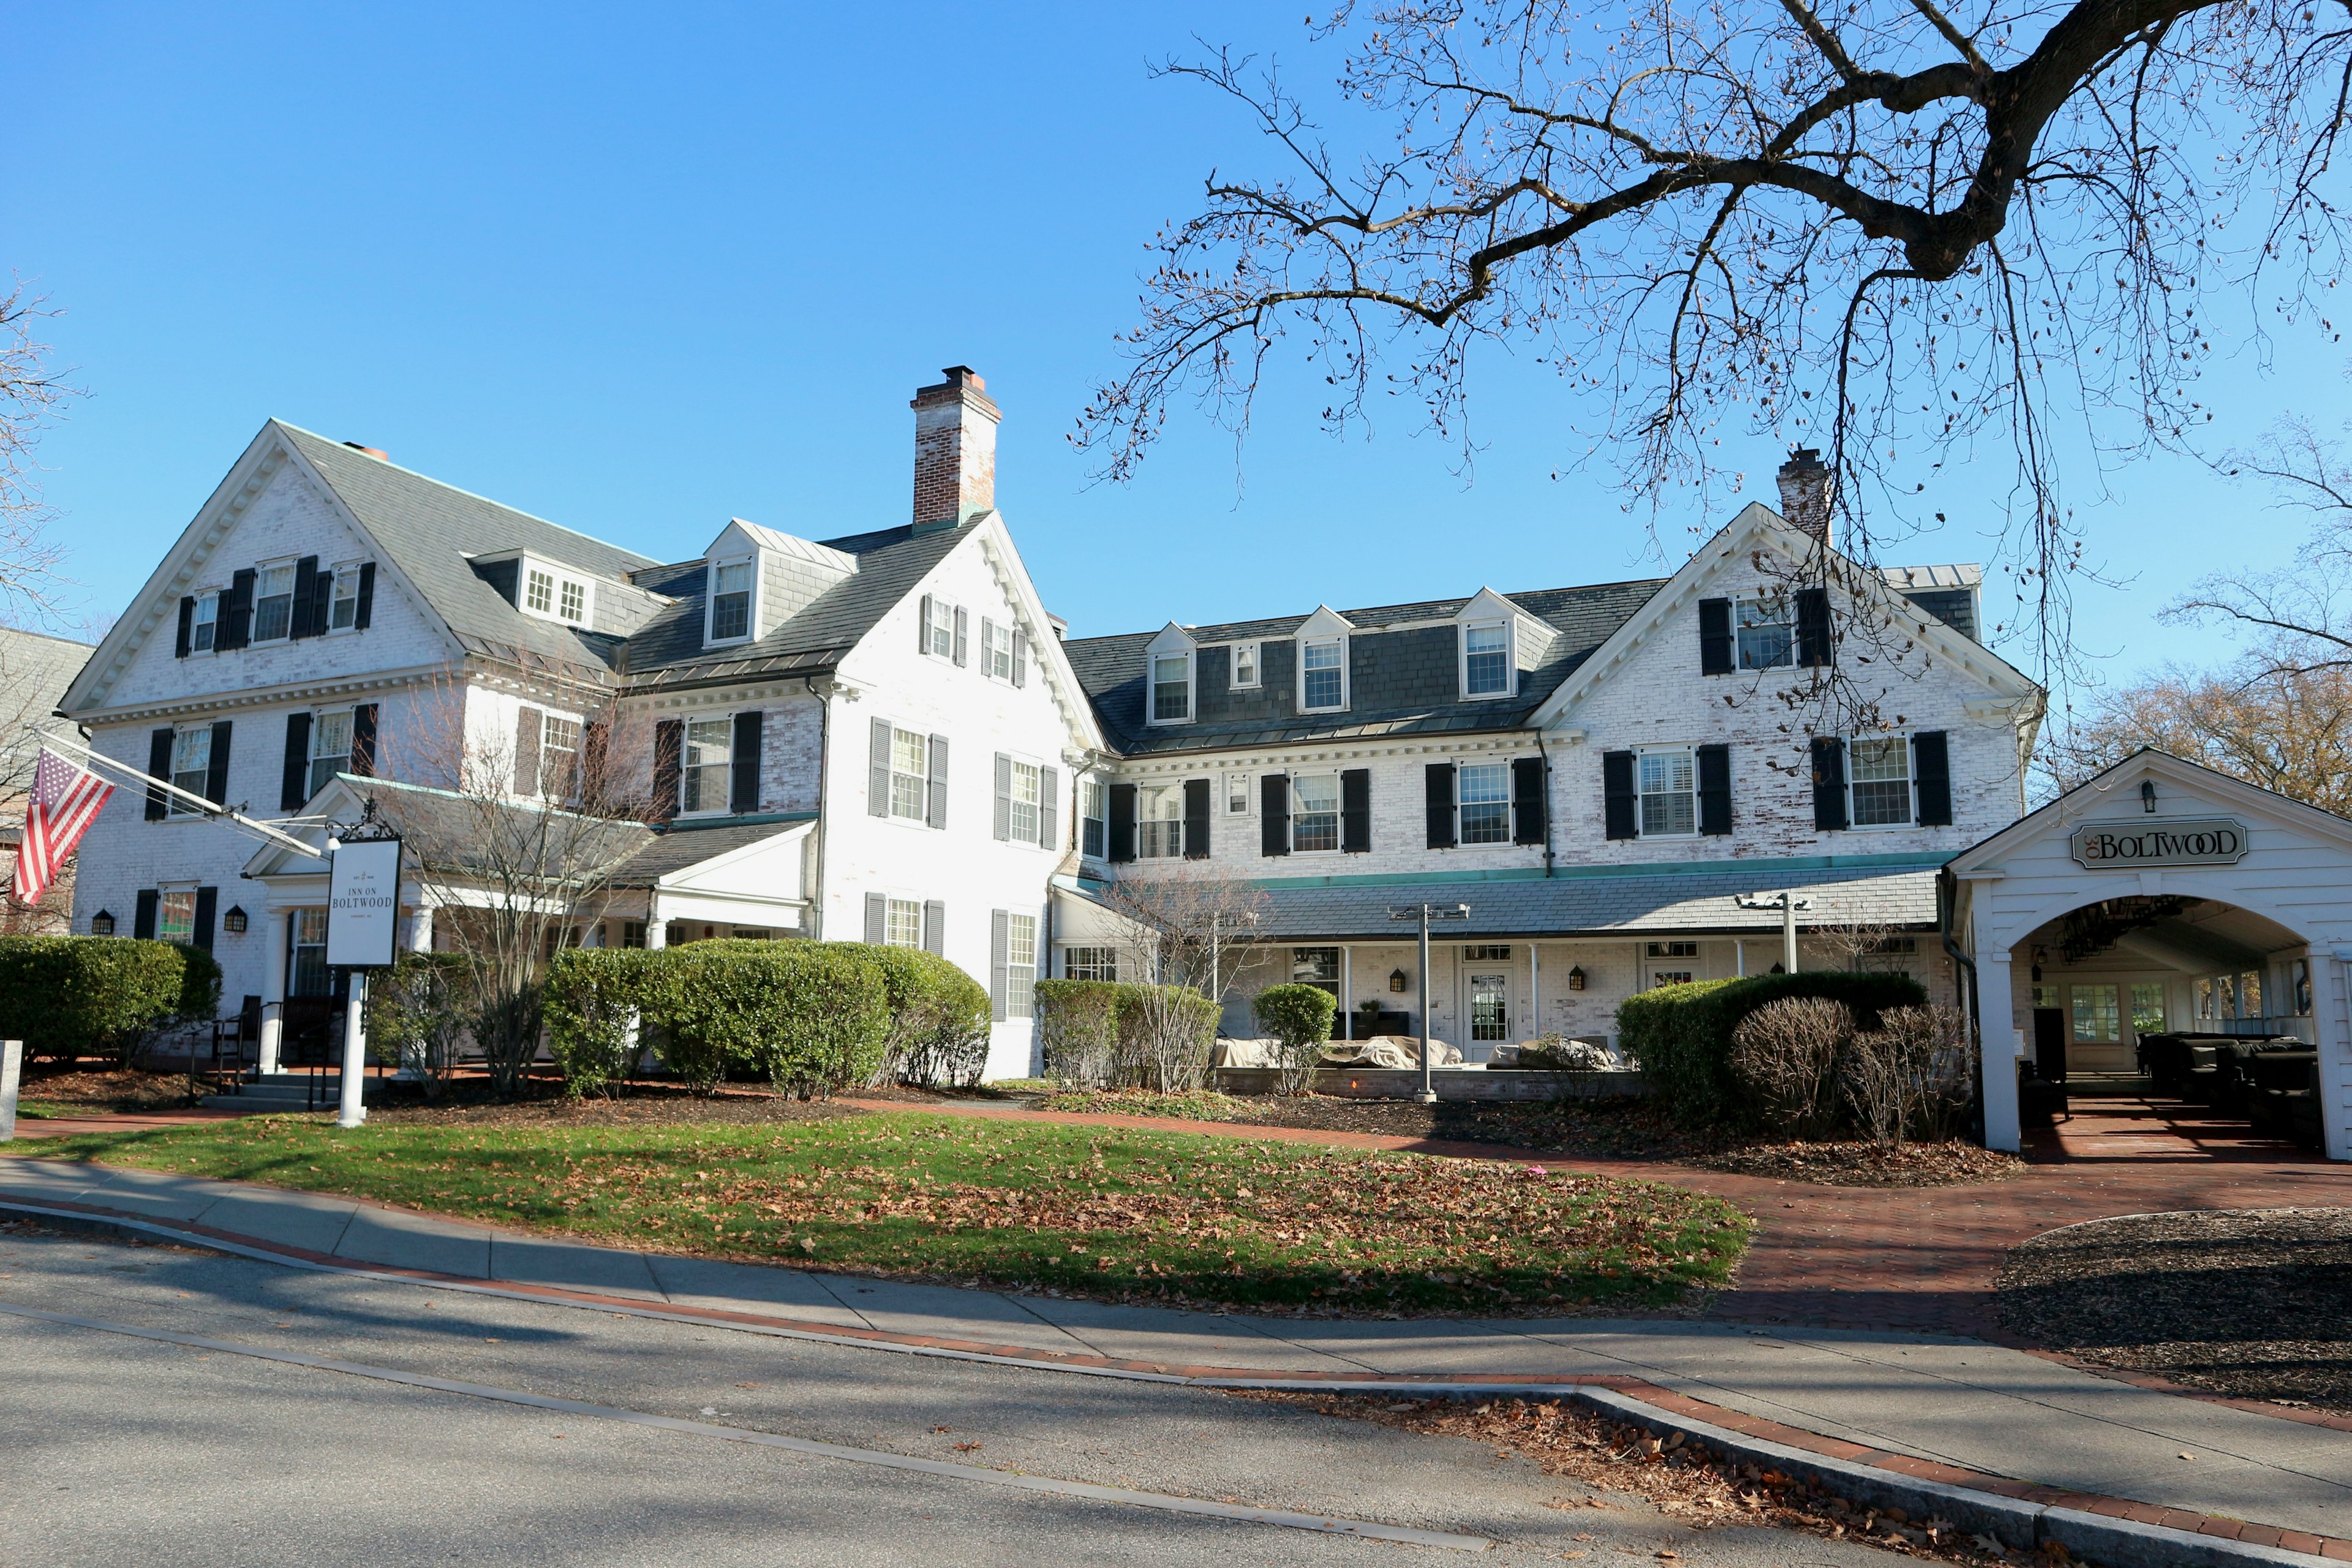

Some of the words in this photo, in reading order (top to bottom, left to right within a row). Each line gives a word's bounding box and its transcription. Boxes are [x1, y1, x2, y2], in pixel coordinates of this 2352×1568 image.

[2084, 835, 2100, 859] 30
[2097, 830, 2238, 859] BOLTWOOD
[333, 897, 392, 908] BOLTWOOD
